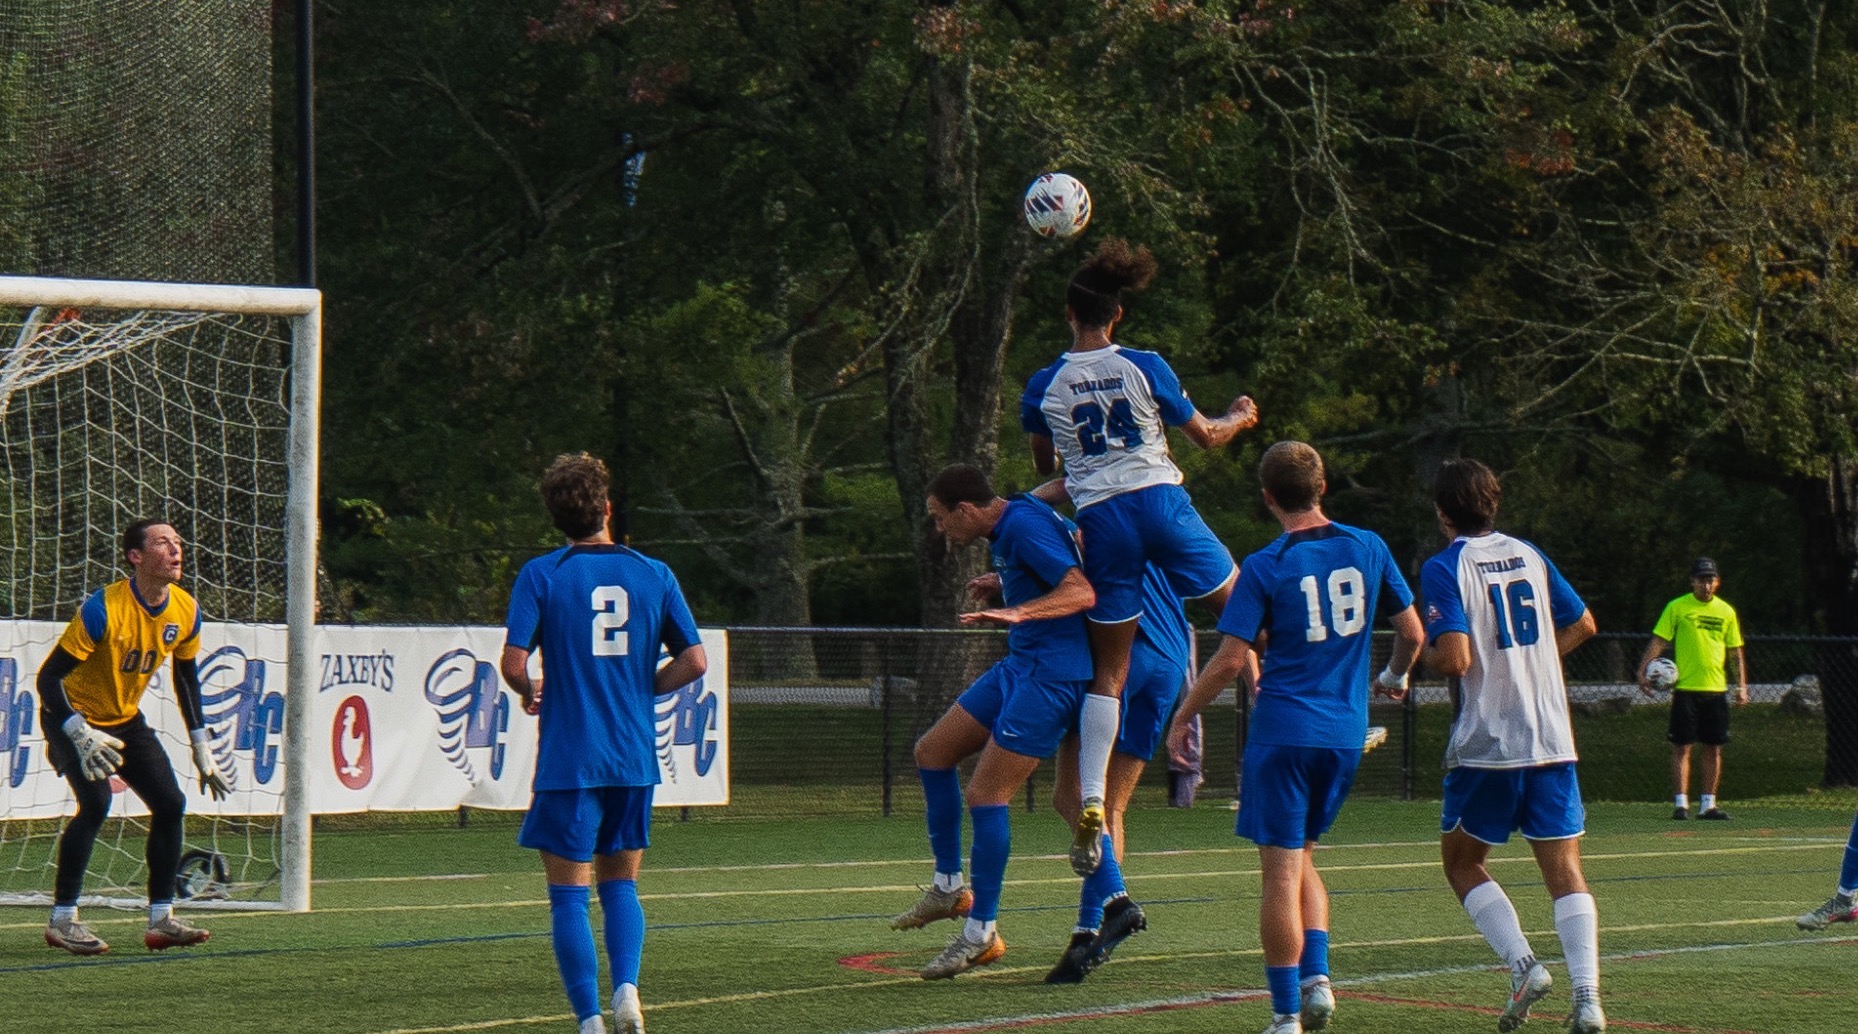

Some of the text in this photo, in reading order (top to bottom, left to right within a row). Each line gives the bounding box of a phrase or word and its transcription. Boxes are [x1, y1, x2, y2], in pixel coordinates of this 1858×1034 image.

[1069, 377, 1123, 395] TORNADOS
[1071, 398, 1144, 455] 24
[1476, 556, 1526, 574] TORNADOS
[591, 585, 630, 657] 2
[1300, 566, 1366, 642] 18
[1488, 578, 1540, 650] 16
[122, 649, 157, 674] 00
[319, 648, 394, 692] ZAXBY'S
